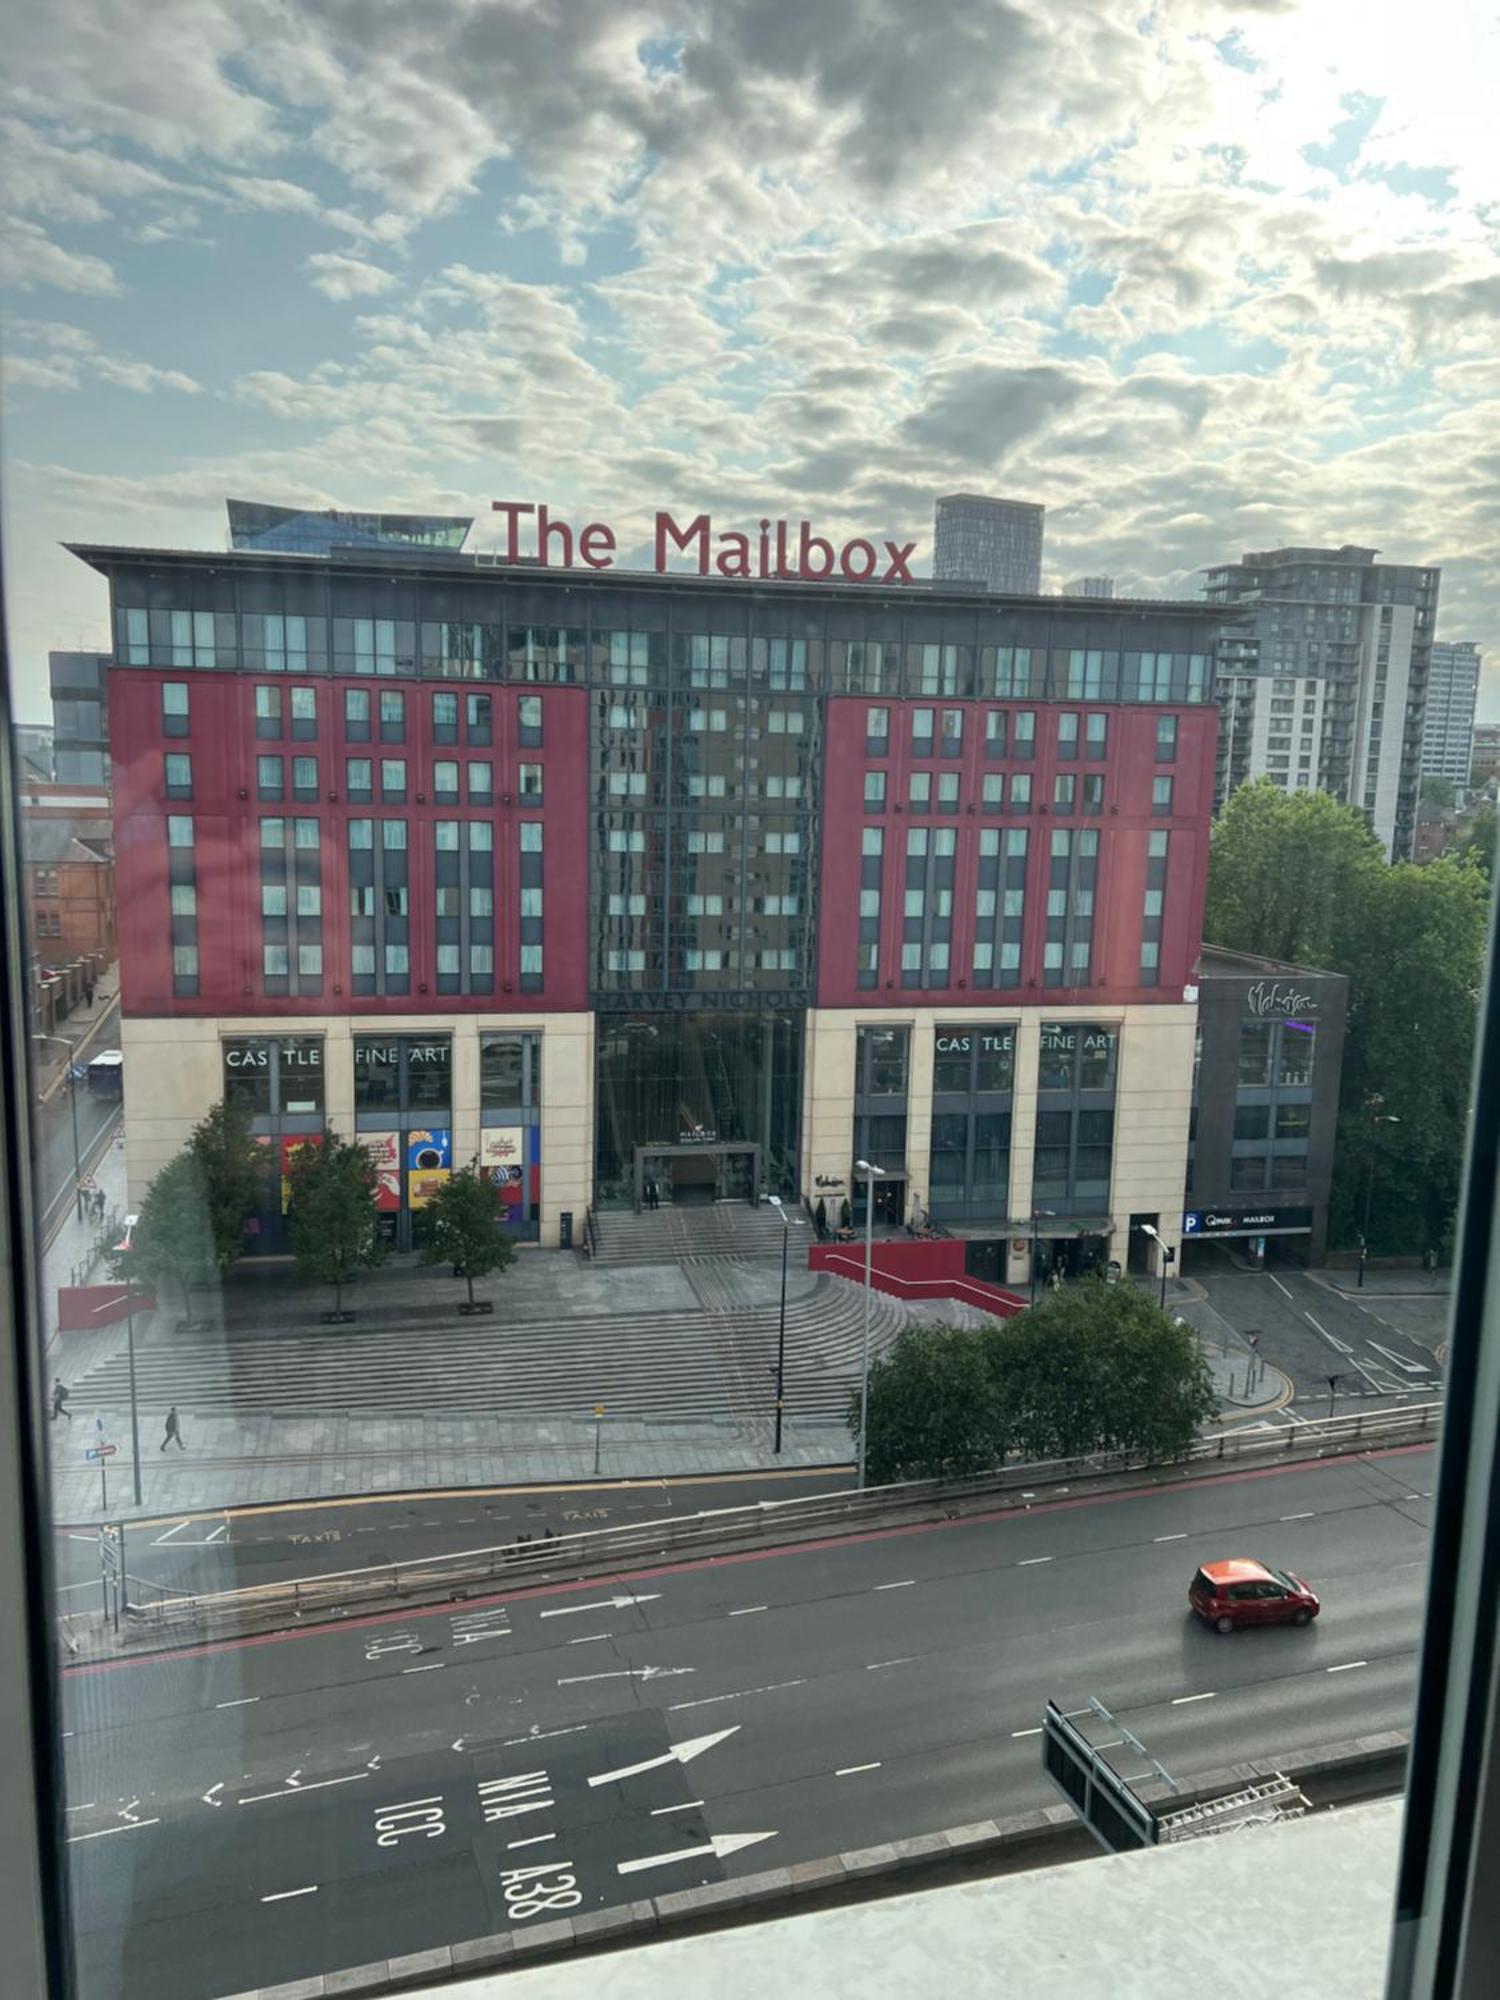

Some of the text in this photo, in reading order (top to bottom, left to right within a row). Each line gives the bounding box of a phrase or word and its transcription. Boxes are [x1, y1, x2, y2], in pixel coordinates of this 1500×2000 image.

[492, 501, 918, 585] The Mailbox
[355, 1049, 398, 1064] FINE
[409, 1047, 449, 1063] ART
[1040, 1034, 1076, 1050] FINE
[1083, 1033, 1117, 1049] ART
[499, 1860, 583, 1920] A38
